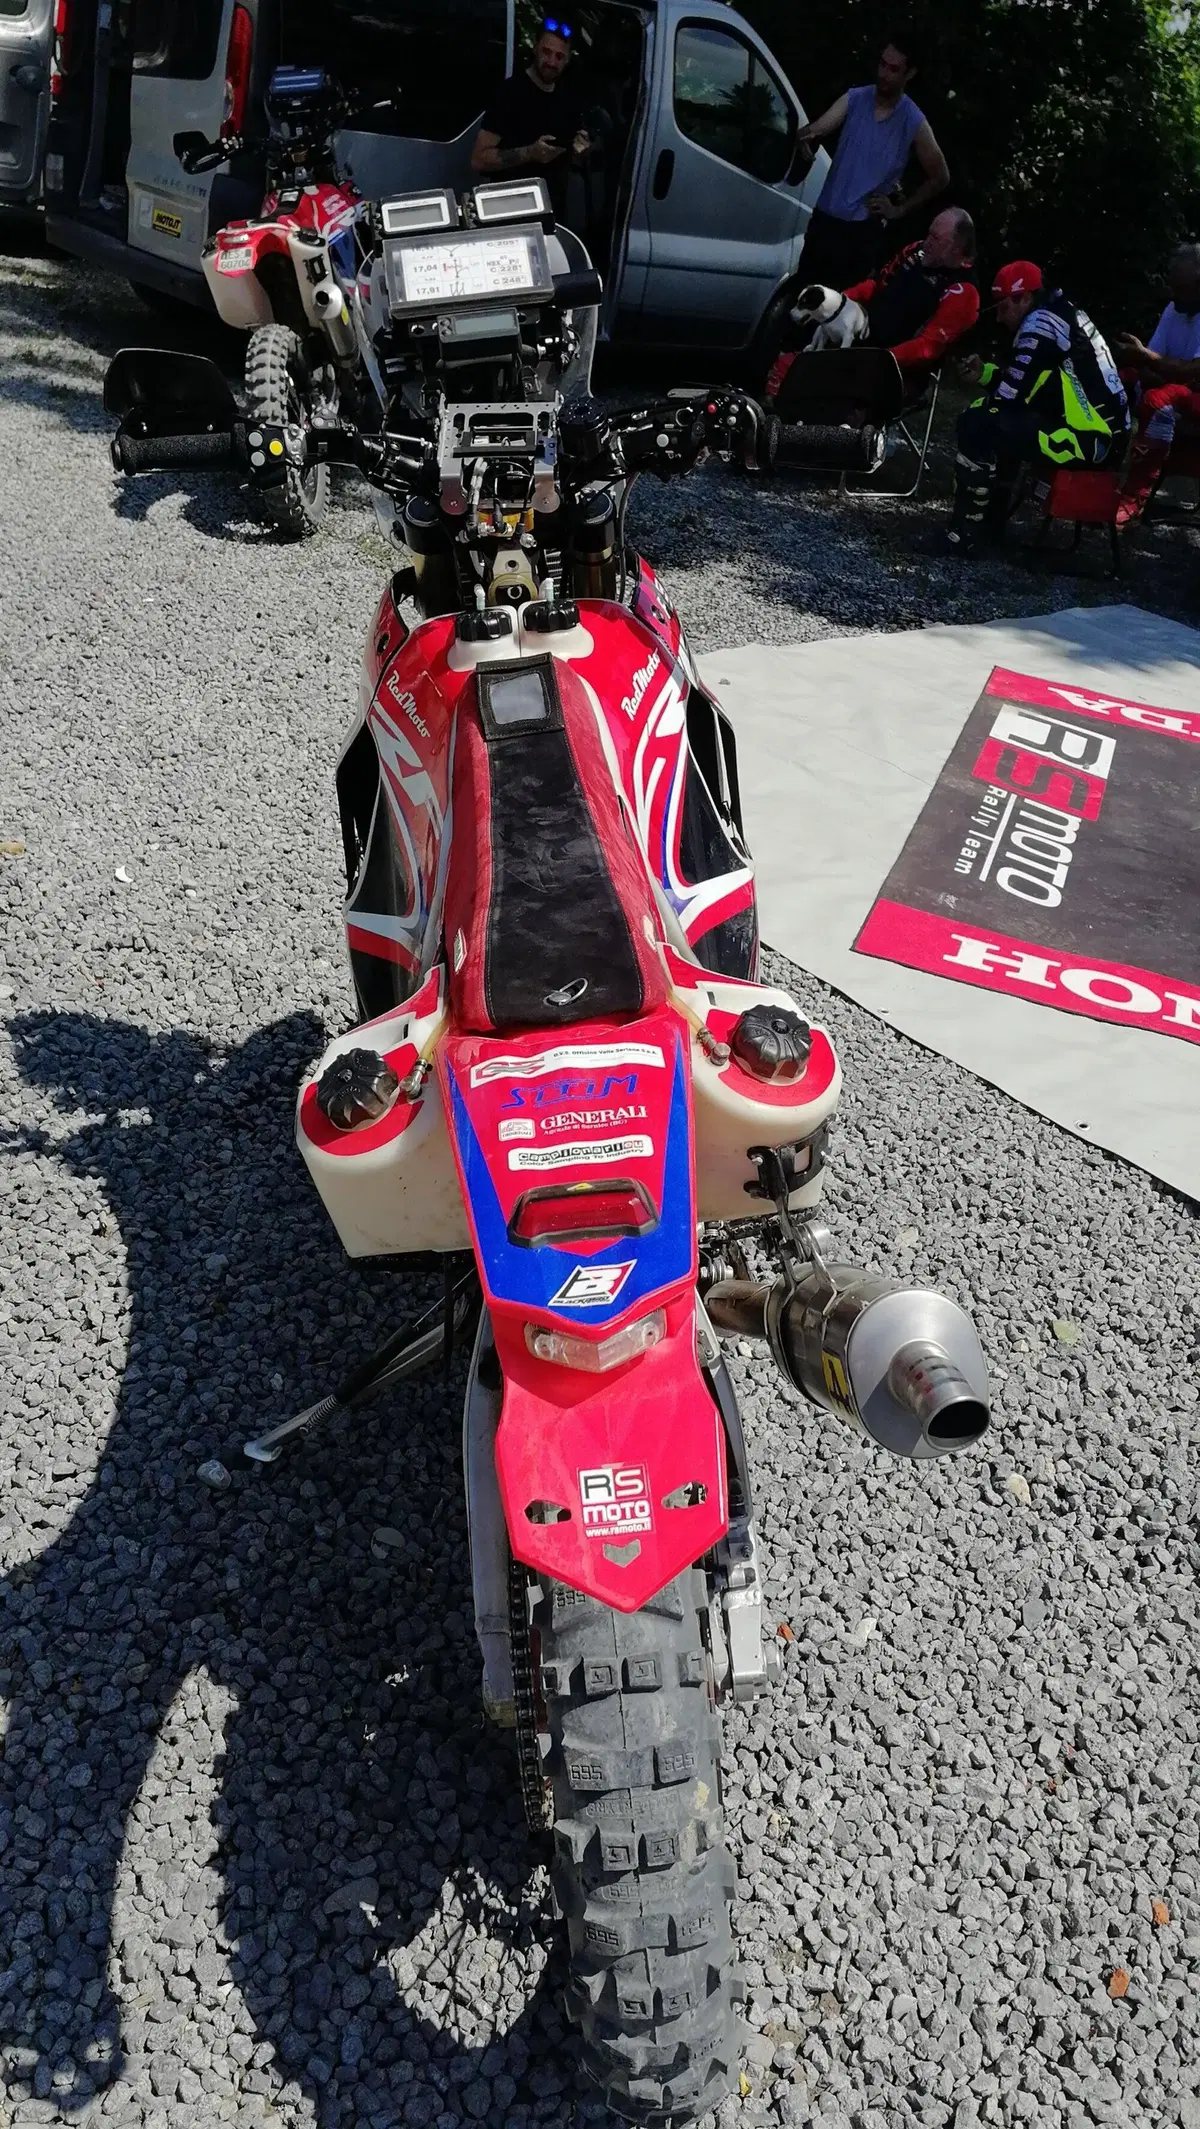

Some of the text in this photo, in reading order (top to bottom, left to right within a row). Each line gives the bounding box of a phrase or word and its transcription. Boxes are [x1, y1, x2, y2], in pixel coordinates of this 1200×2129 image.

[621, 647, 661, 722] RedMoto
[386, 669, 431, 738] RedMoto
[1047, 686, 1200, 736] DA
[971, 785, 1008, 828] Rally
[540, 1105, 648, 1130] GENERALI
[547, 1155, 590, 1165] Sampling
[582, 1469, 644, 1500] RS
[571, 1764, 603, 1781] 695
[587, 1929, 620, 1946] 695
